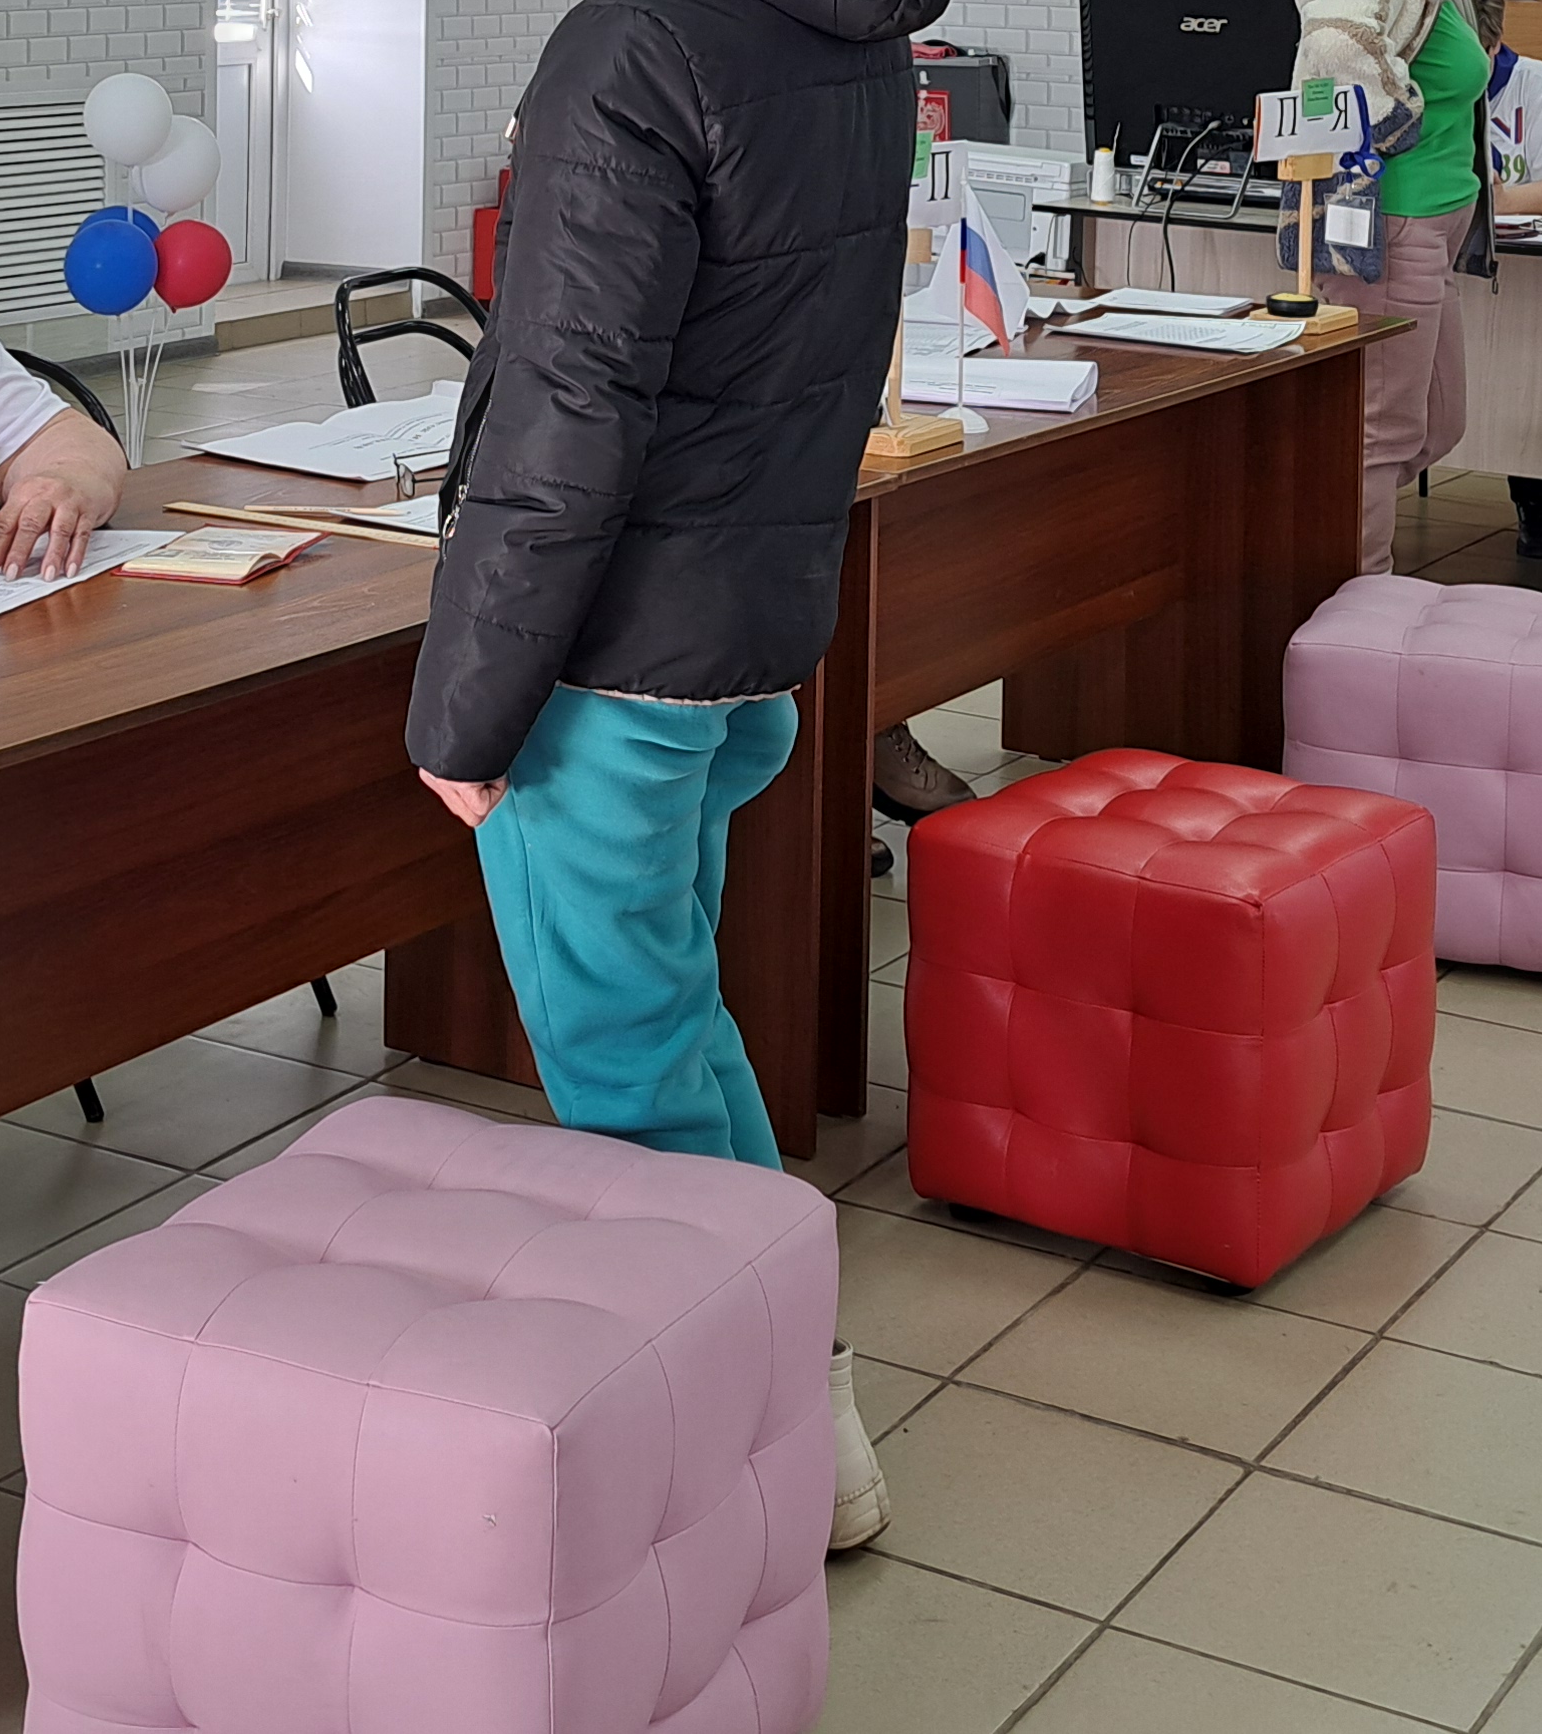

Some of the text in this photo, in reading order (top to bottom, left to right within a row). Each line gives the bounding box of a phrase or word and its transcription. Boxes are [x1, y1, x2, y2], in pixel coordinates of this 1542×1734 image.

[1180, 16, 1228, 33] acer
[1275, 96, 1299, 138] П
[1329, 89, 1350, 132] Я
[926, 150, 952, 202] П
